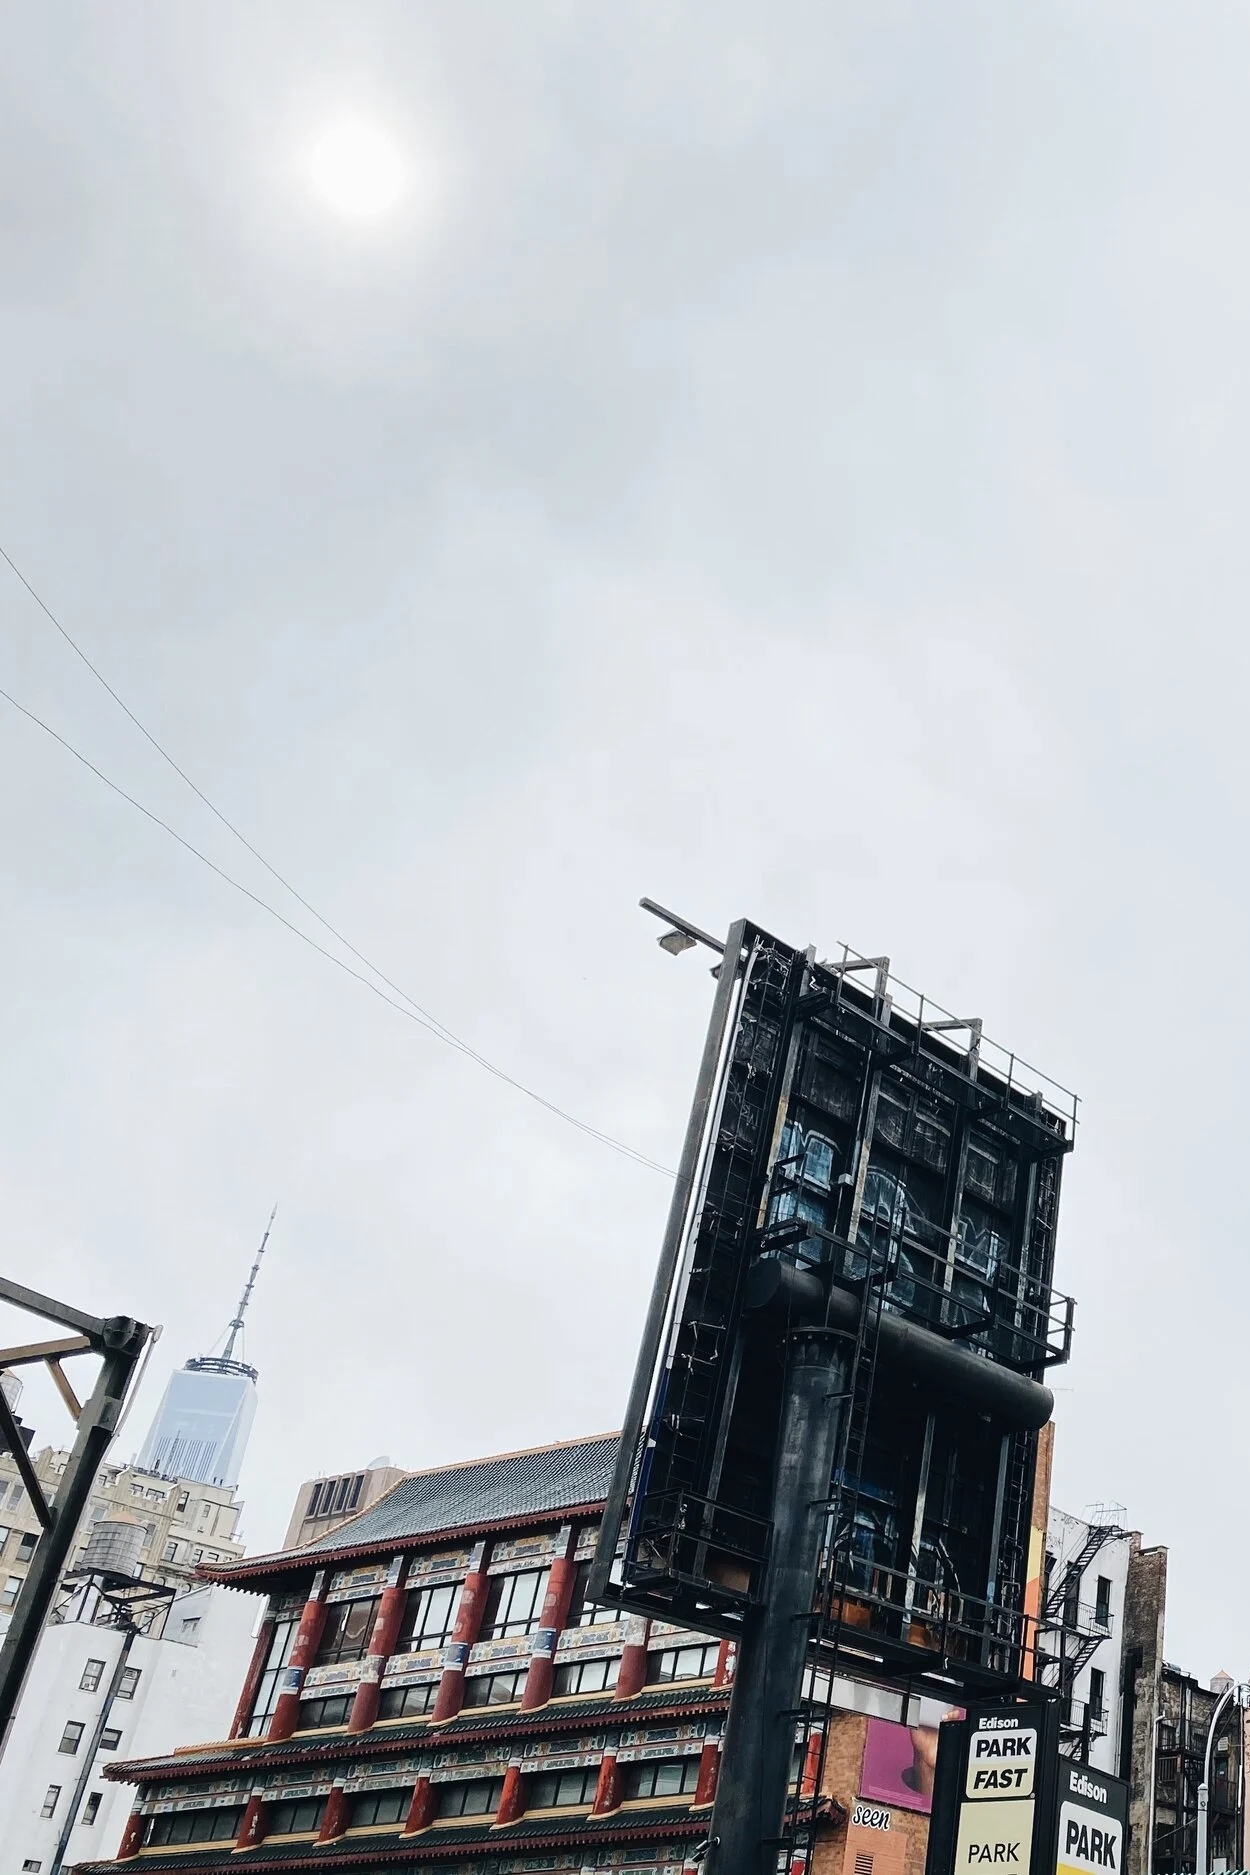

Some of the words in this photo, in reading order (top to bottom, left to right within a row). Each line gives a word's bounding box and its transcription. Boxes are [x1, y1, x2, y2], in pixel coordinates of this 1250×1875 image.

[978, 1716, 1018, 1730] Edison
[975, 1736, 1032, 1758] PARK
[973, 1768, 1028, 1790] FAST
[1069, 1770, 1107, 1804] Edison
[852, 1805, 891, 1830] seen
[968, 1842, 1020, 1863] PARK
[1065, 1819, 1117, 1869] PARK
